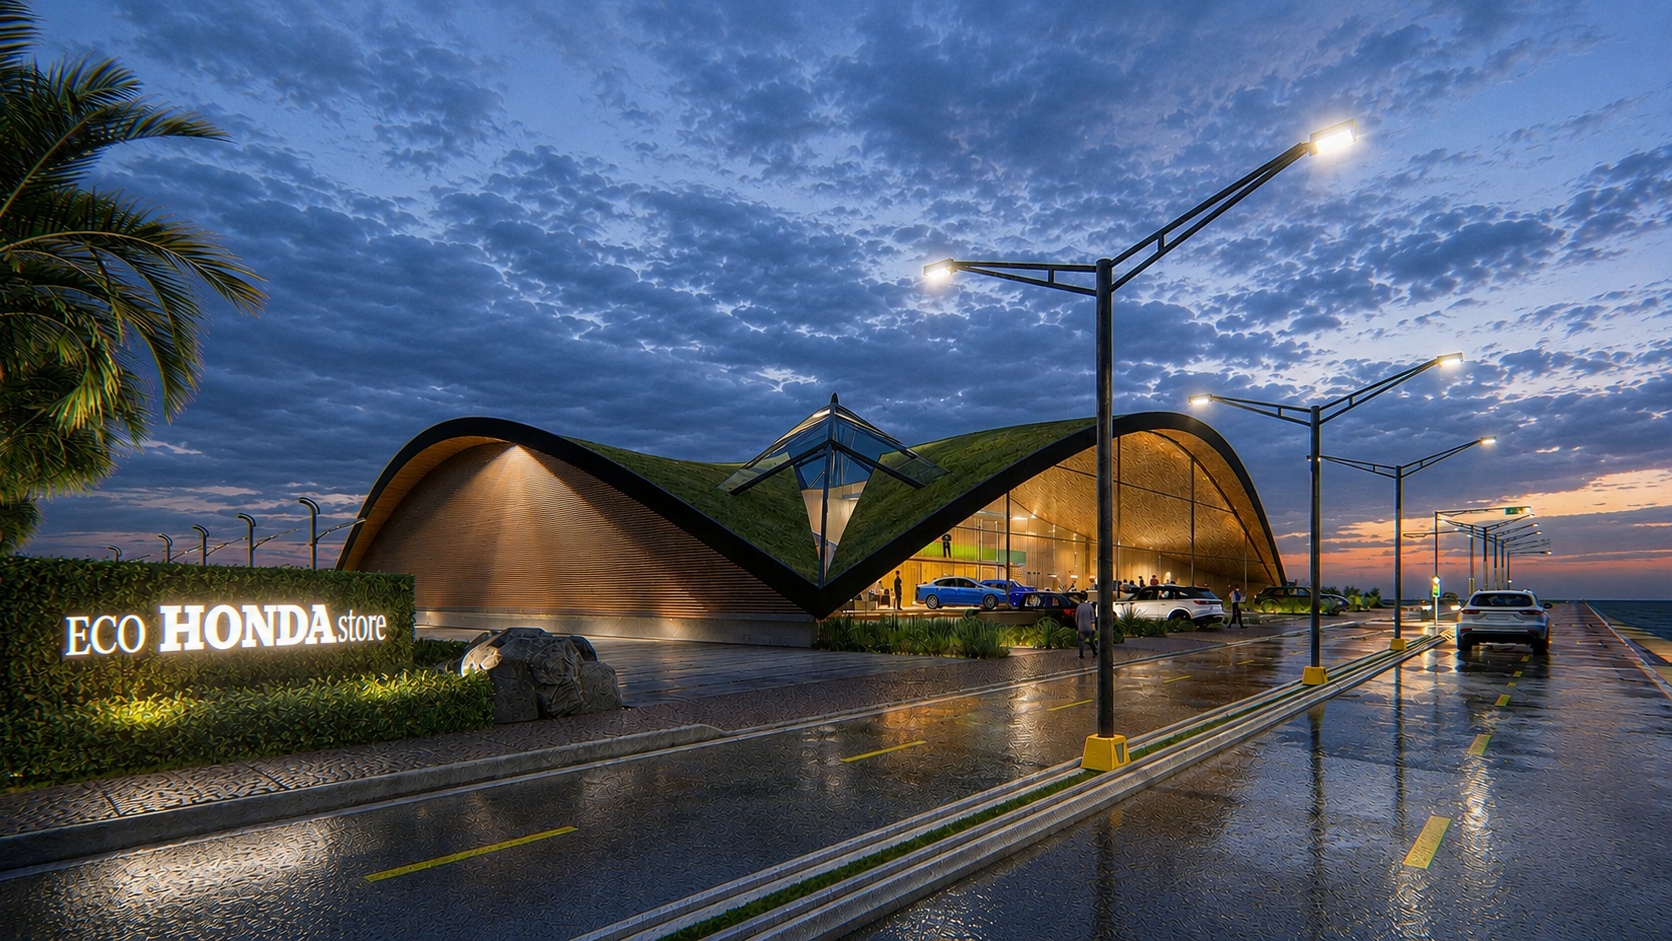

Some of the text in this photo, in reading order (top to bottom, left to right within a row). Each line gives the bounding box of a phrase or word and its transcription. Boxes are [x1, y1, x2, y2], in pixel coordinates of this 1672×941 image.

[65, 604, 387, 656] ECO HONDA store
